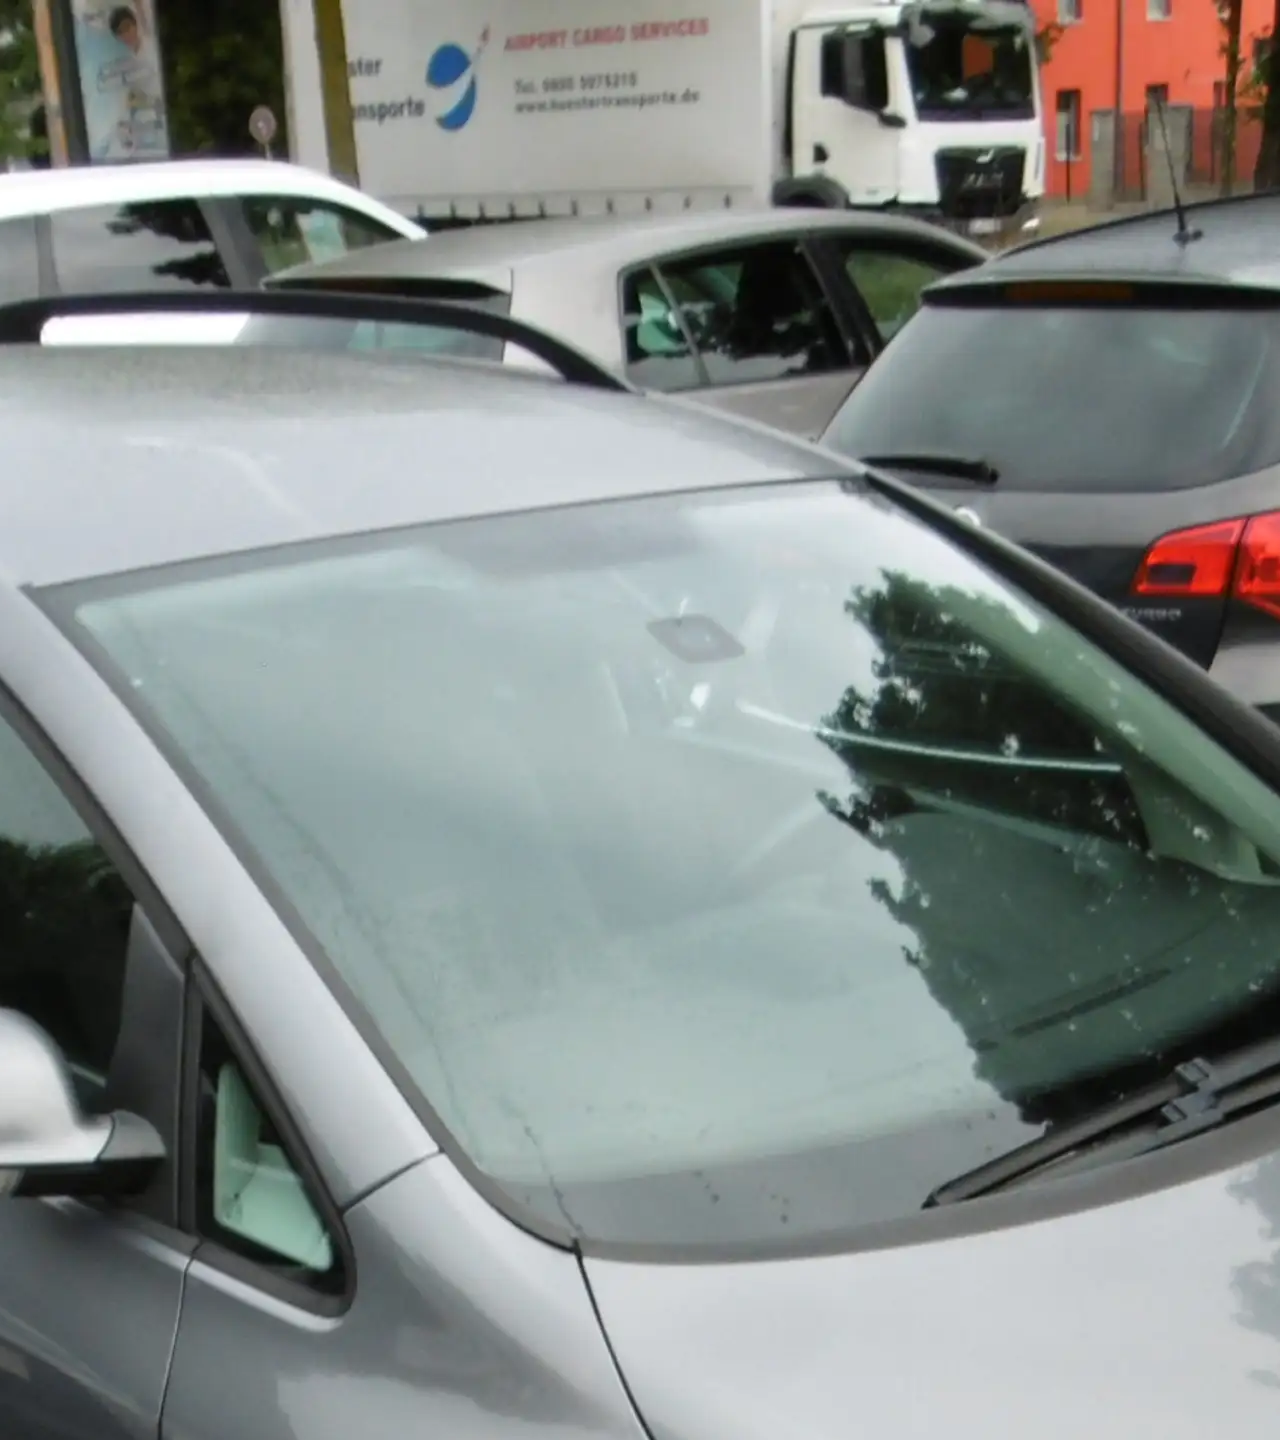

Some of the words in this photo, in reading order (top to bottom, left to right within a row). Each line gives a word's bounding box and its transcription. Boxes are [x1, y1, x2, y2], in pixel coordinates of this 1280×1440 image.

[504, 29, 568, 51] AIRPORT
[572, 25, 626, 46] CARGO
[630, 17, 710, 42] SERVICES
